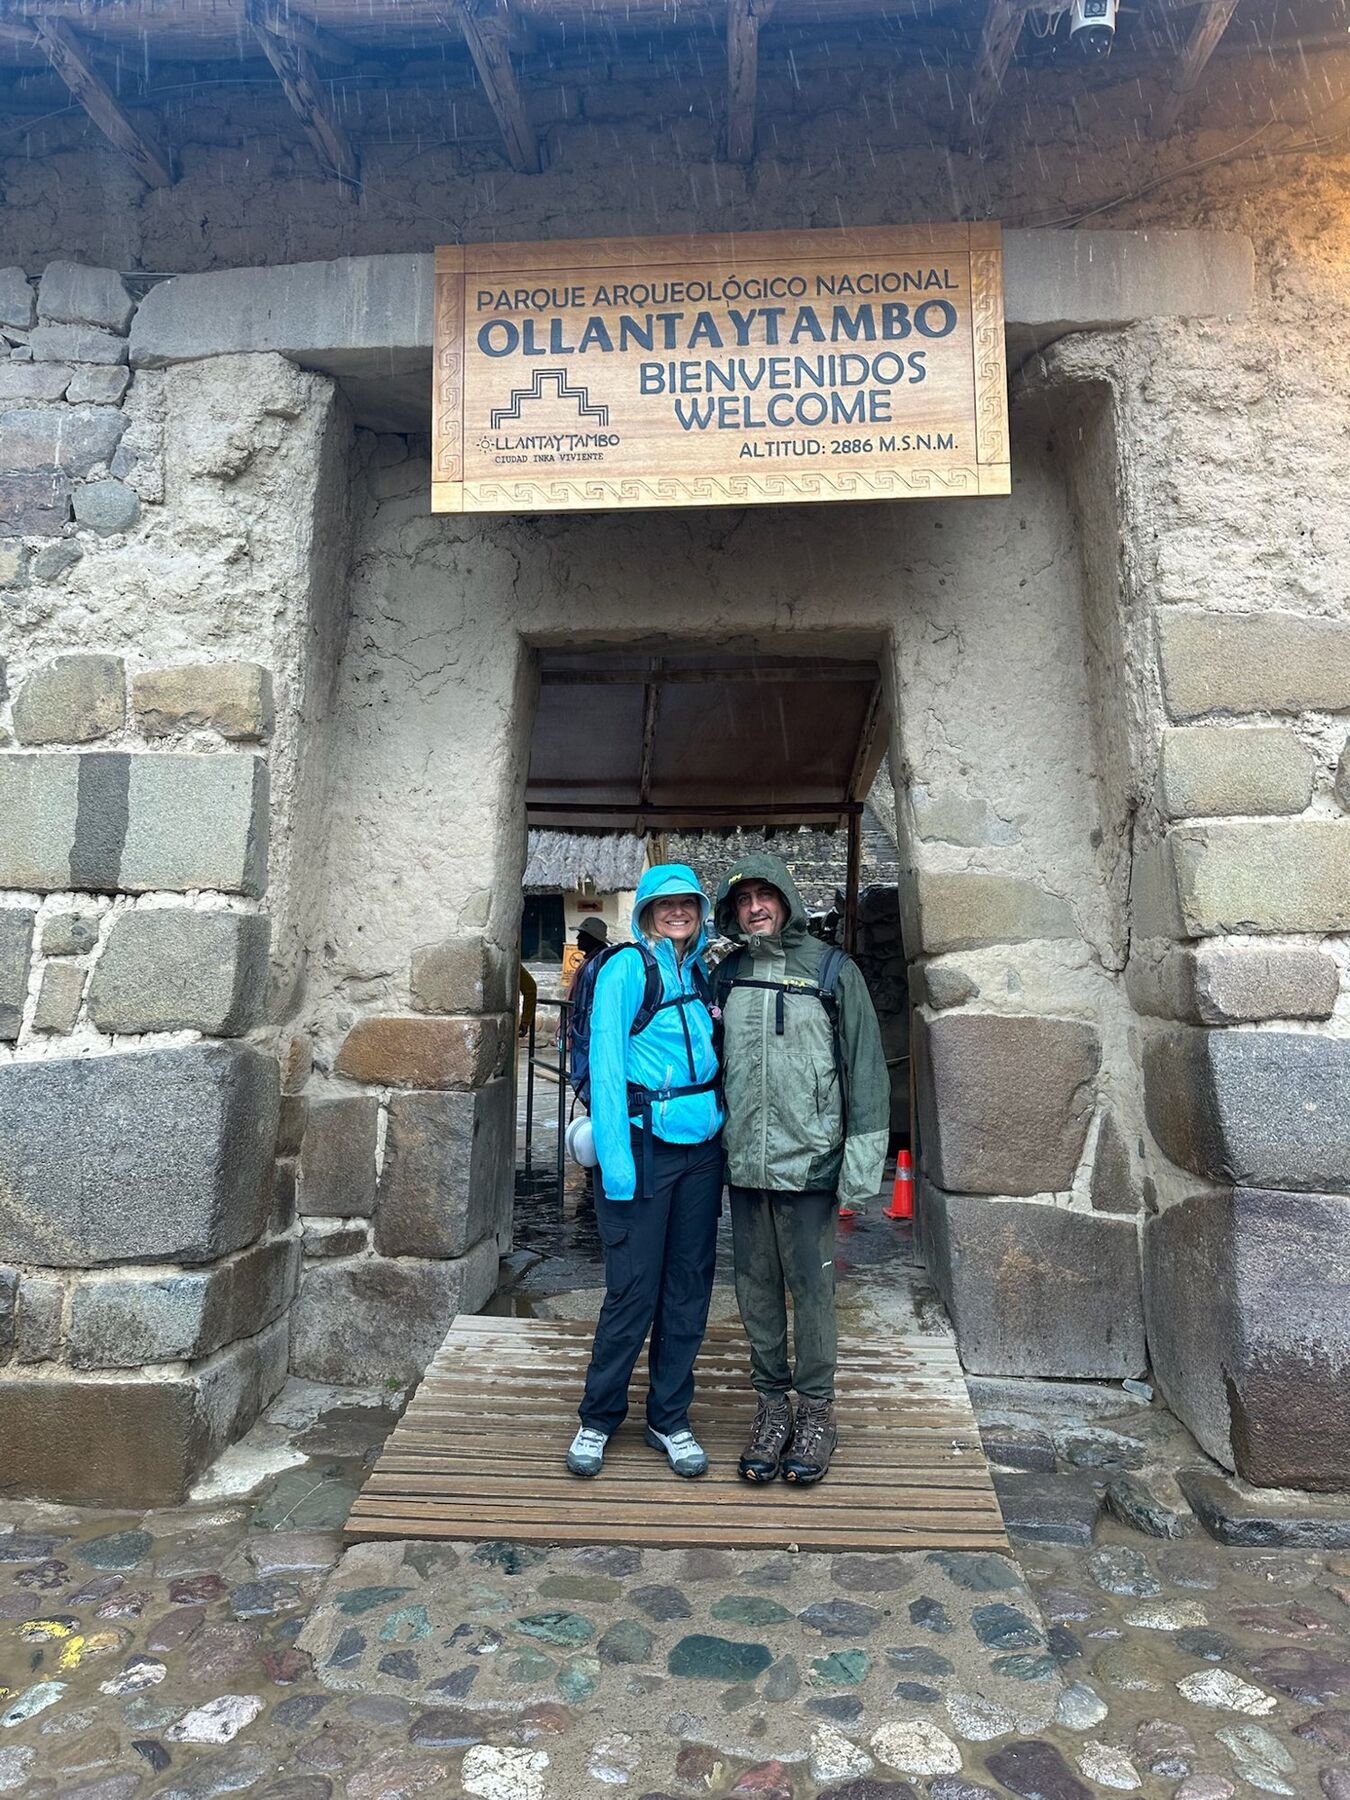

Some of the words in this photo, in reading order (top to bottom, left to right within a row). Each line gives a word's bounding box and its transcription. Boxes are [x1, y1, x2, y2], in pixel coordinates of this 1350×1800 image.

[477, 287, 586, 311] PARQUE
[592, 274, 808, 308] ARQUEOLÓGICO
[816, 269, 959, 296] NACIONAL
[477, 299, 958, 357] OLLANTAYTAMBO
[640, 351, 927, 394] BIENVENIDOS
[675, 389, 893, 431] WELCOME
[495, 455, 528, 464] CIUDAD
[533, 454, 555, 463] INKA
[560, 452, 604, 462] VIVIENTE
[739, 440, 826, 458] ALTITUD:
[830, 438, 873, 454] 2886
[879, 433, 959, 451] M.S.N.M.
